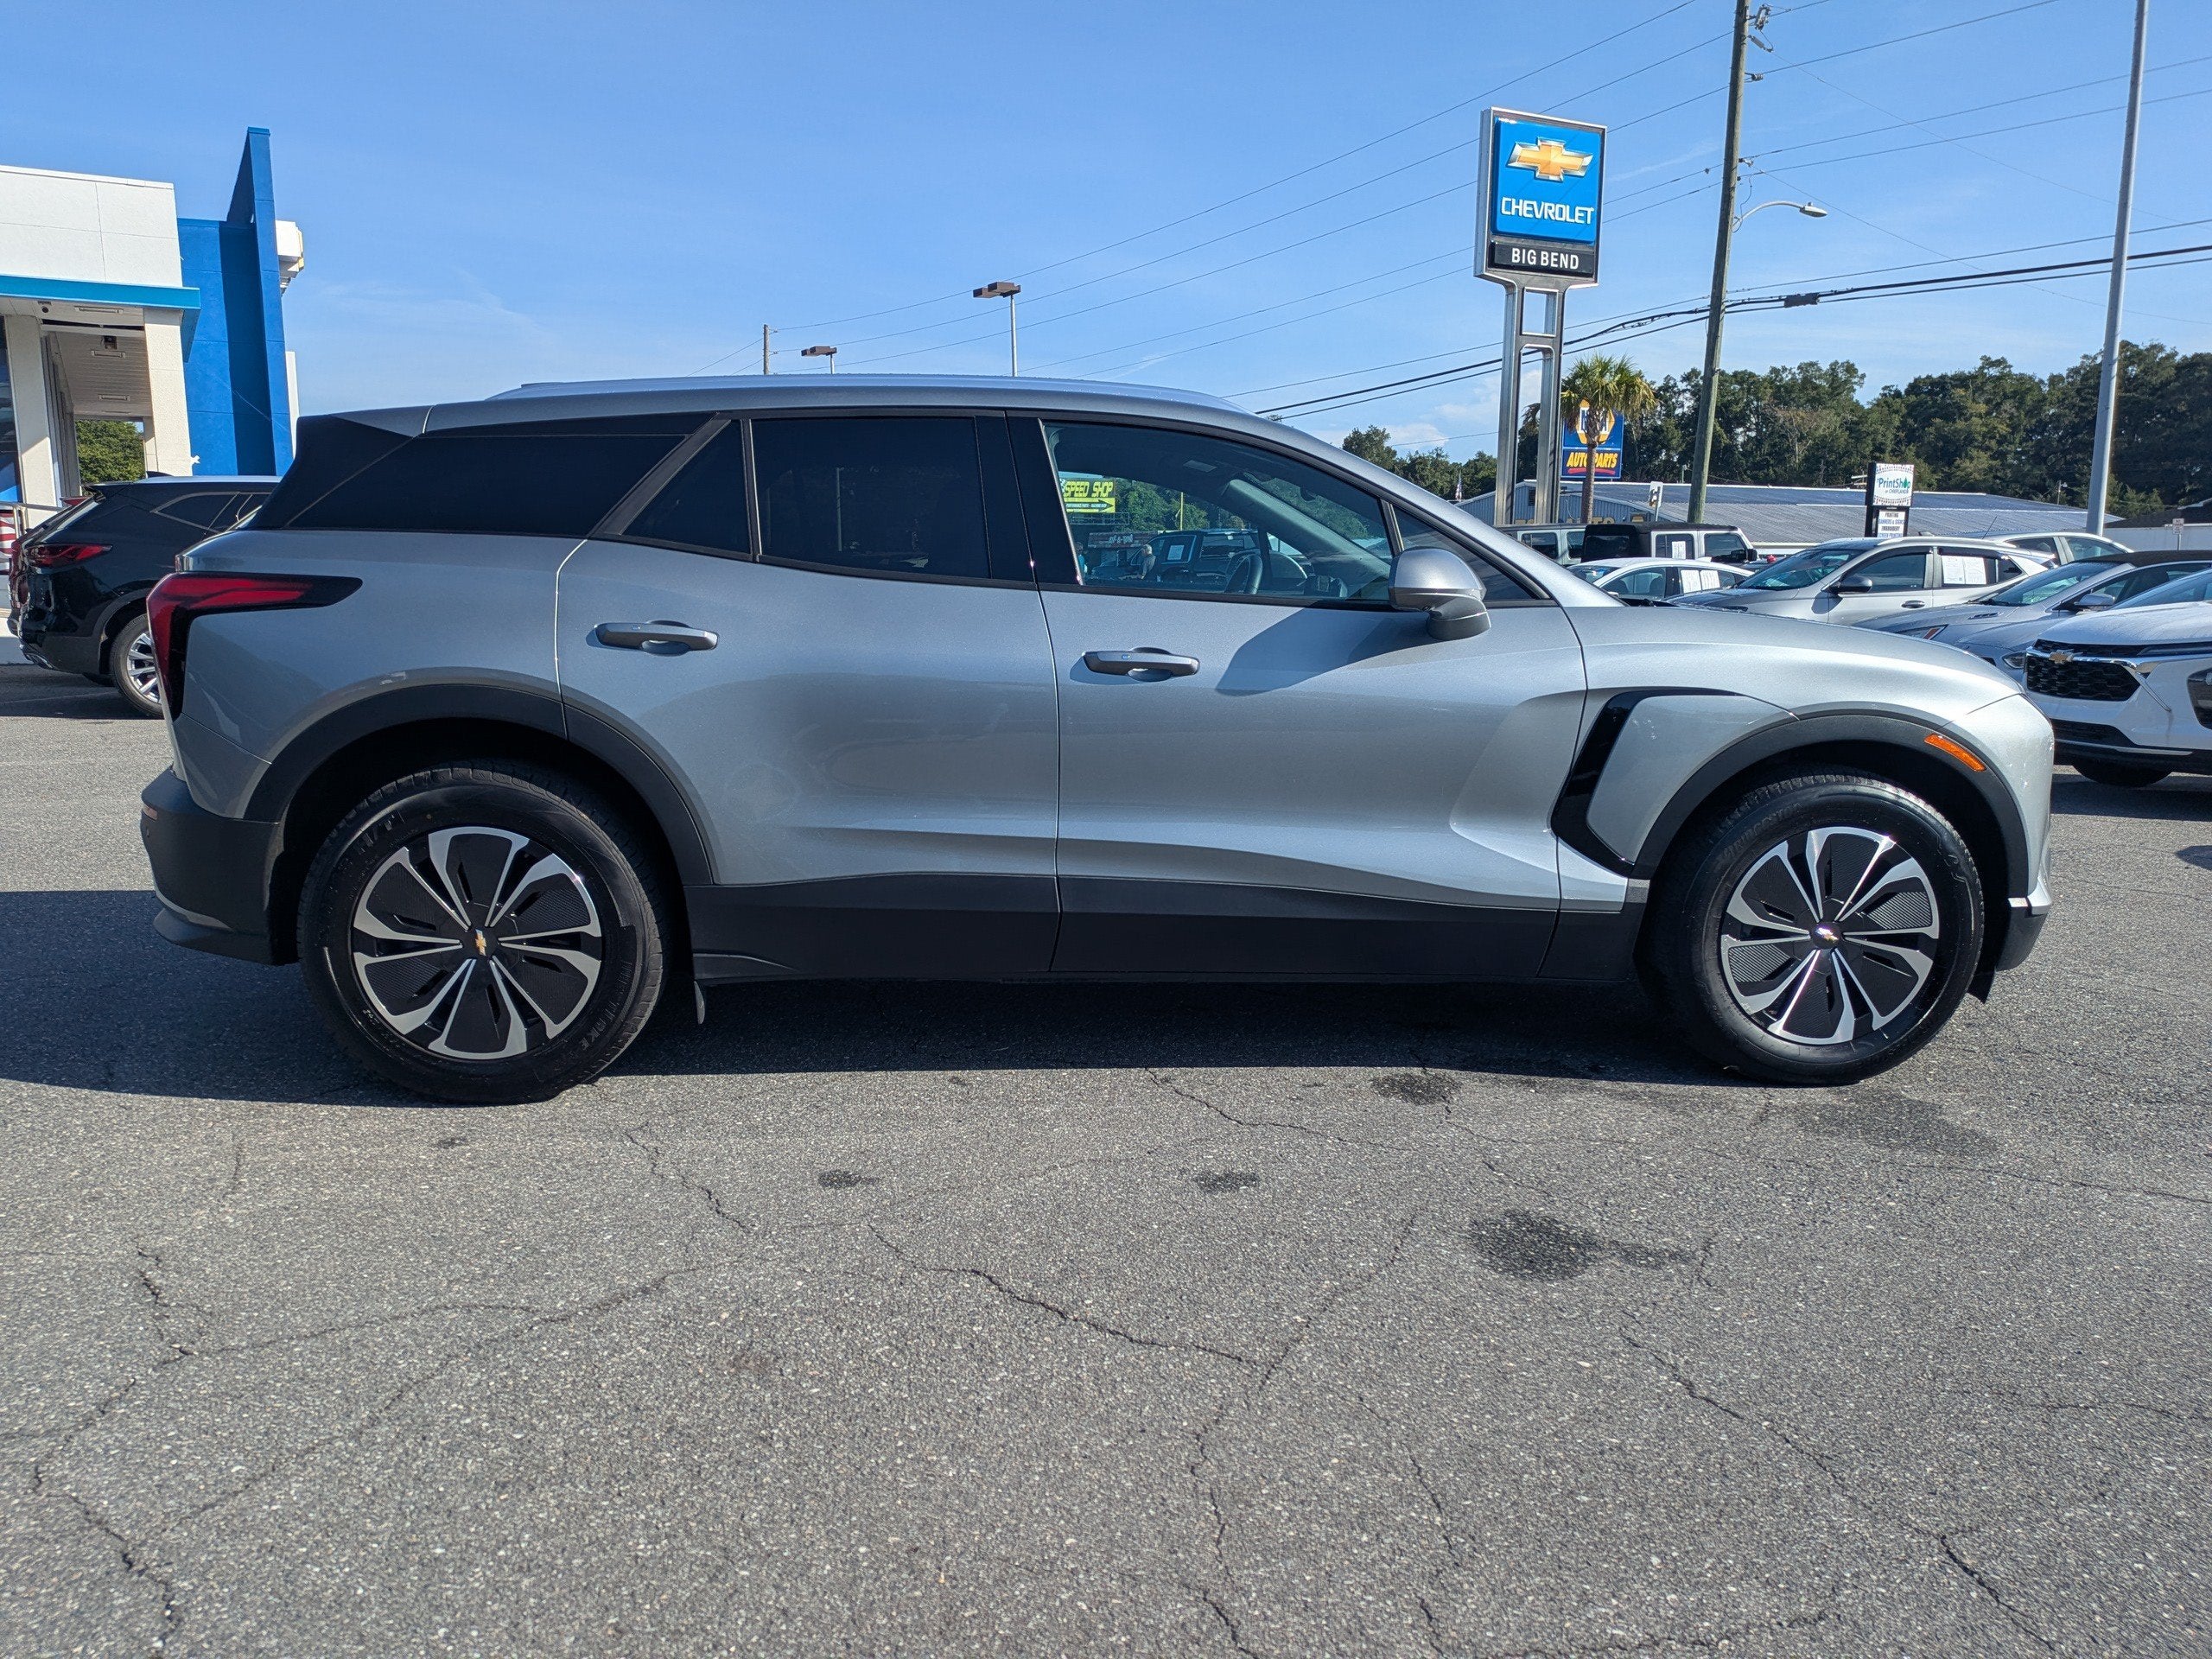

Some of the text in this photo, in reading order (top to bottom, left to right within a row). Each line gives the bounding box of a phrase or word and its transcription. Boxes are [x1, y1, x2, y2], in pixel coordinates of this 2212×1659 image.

[1501, 197, 1595, 225] CHEVROLET
[1511, 247, 1580, 270] BIG BEND
[1064, 480, 1114, 498] SPEED SHOP
